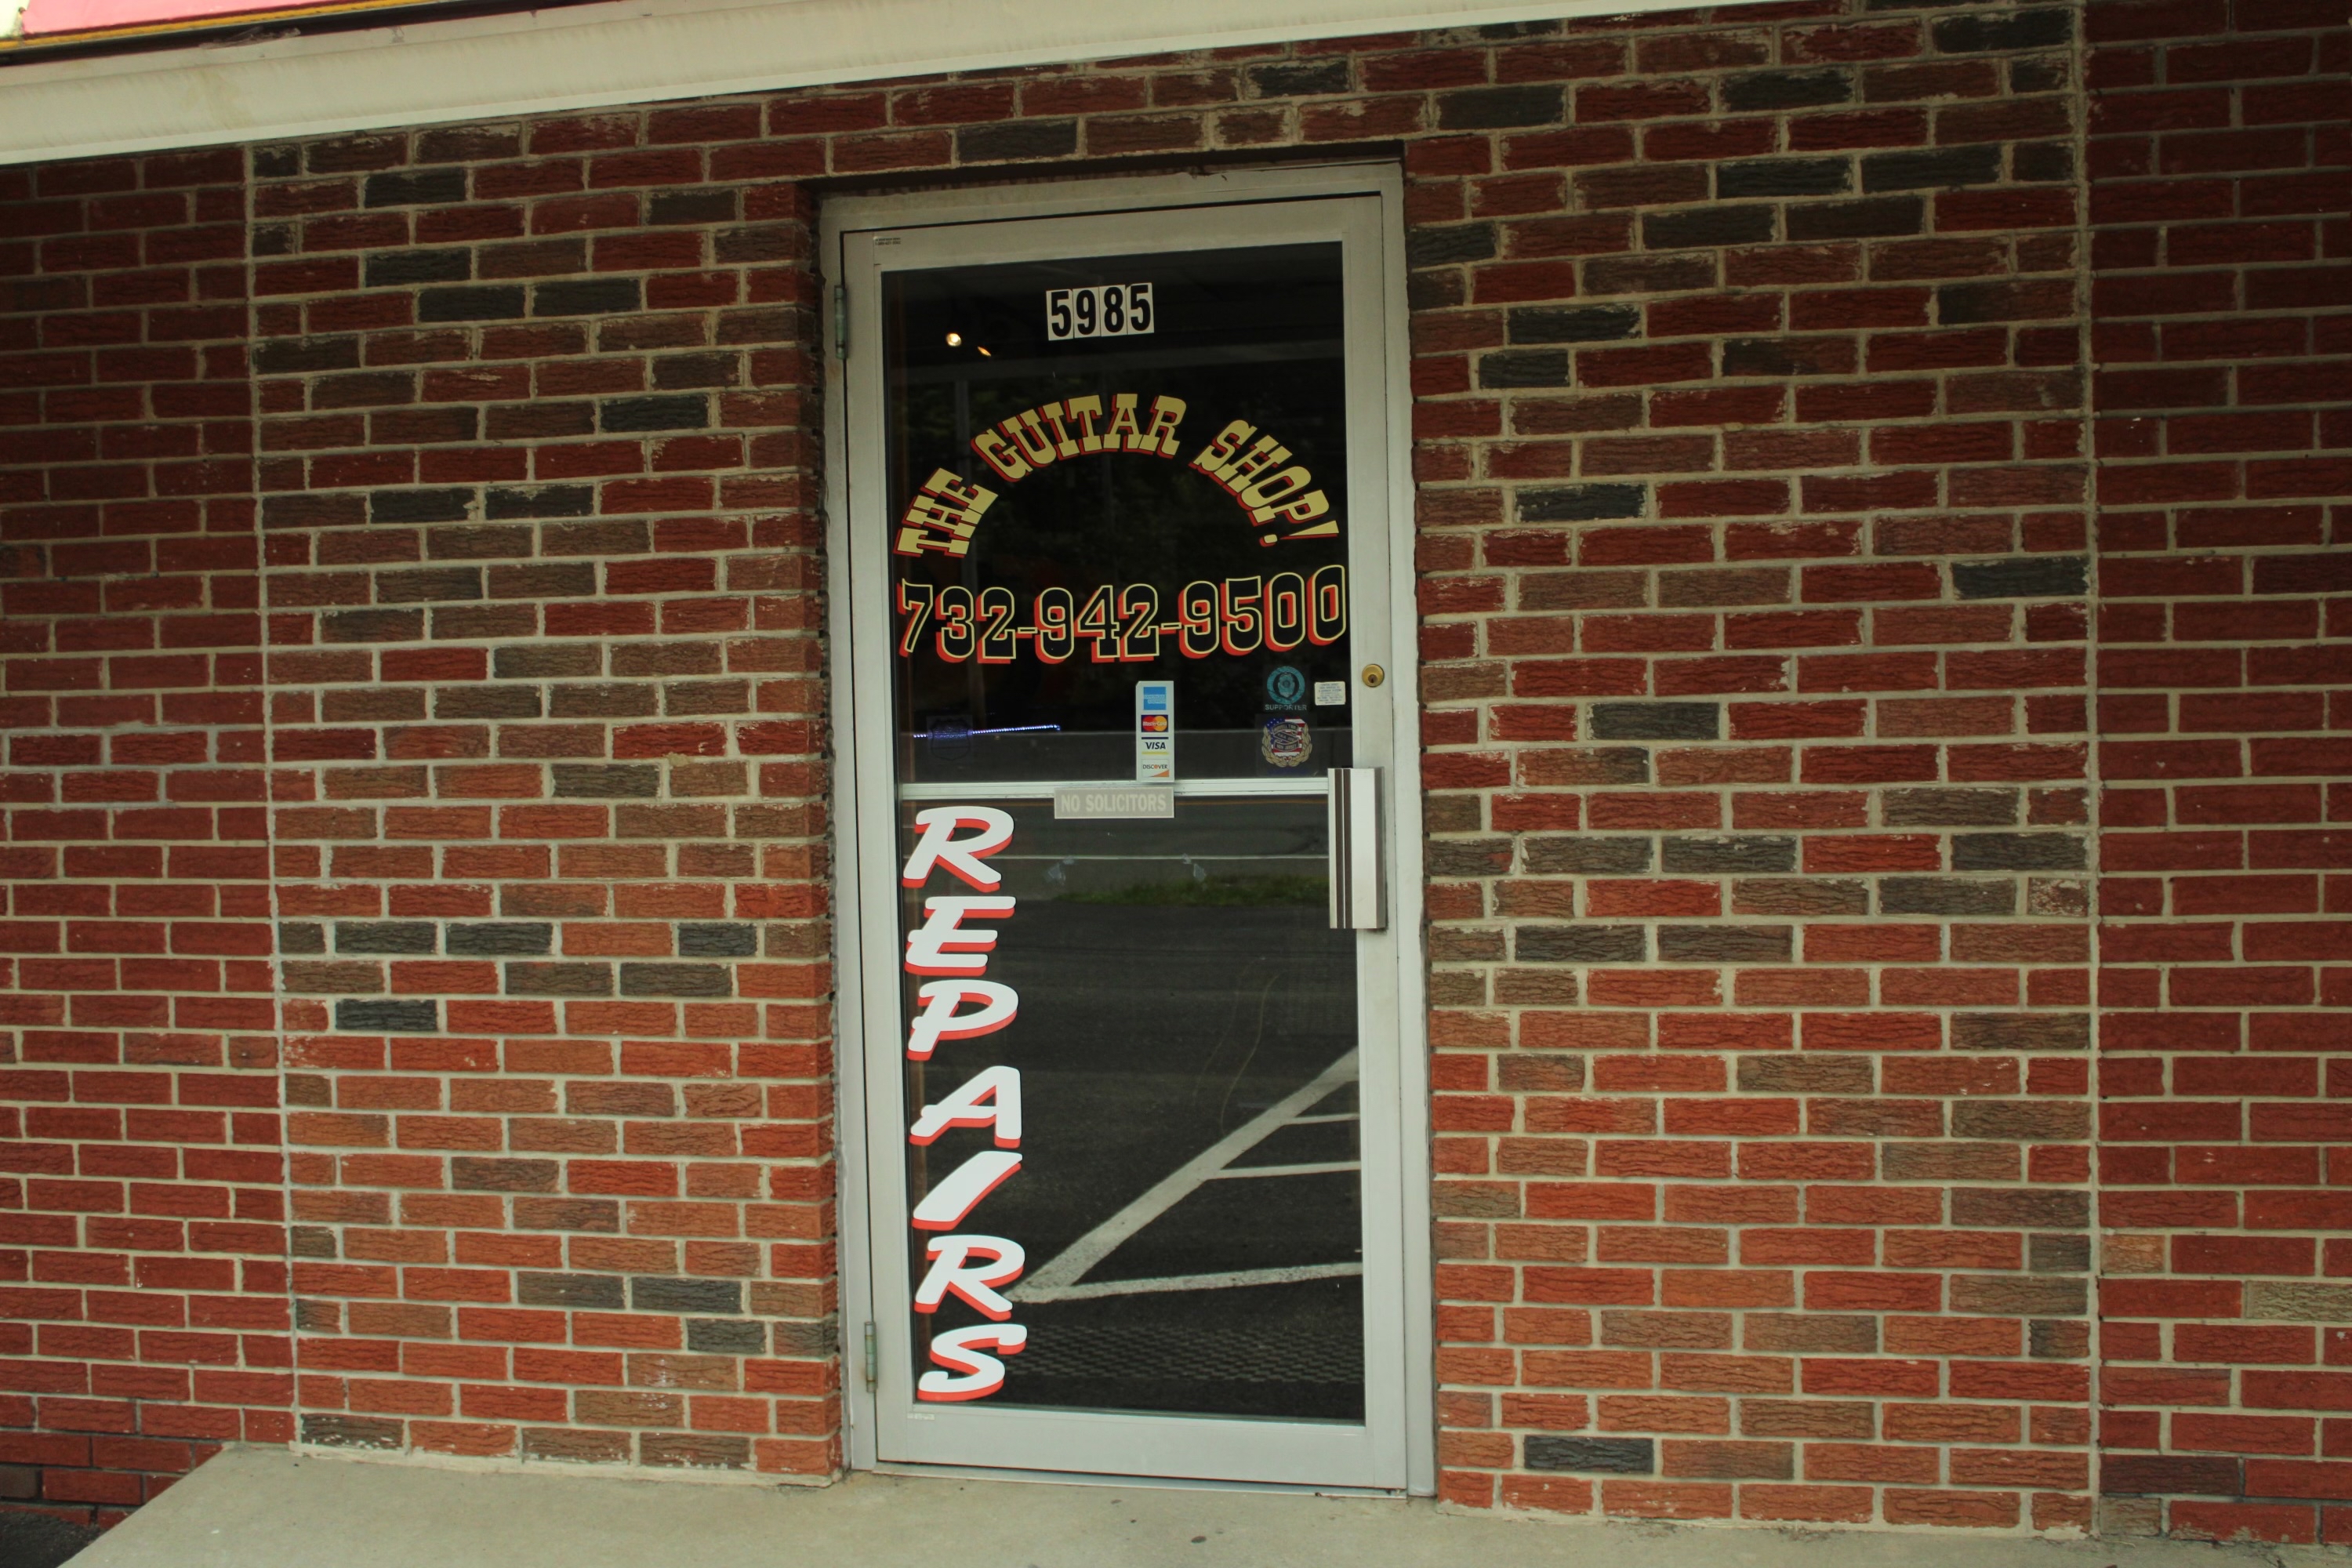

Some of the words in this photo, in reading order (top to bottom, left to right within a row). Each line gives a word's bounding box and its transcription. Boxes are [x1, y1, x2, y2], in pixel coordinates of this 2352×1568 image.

[1051, 284, 1152, 337] 5985
[893, 468, 998, 557] THE
[971, 394, 1186, 482] GUITAR
[1189, 419, 1339, 546] SHOP!
[898, 564, 1346, 663] 732-942-9500
[1062, 794, 1080, 812] NO
[1086, 793, 1167, 812] SOLICITORS
[902, 806, 1027, 1401] REPAIRS
